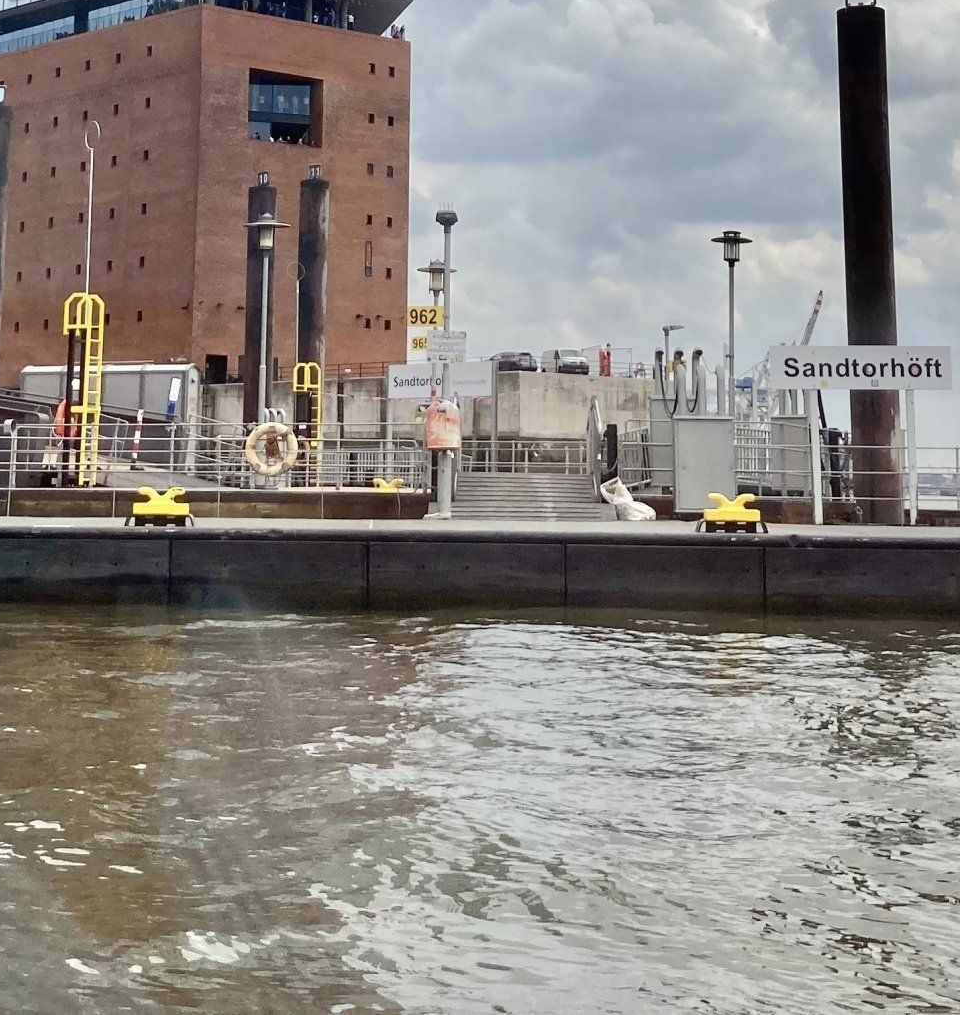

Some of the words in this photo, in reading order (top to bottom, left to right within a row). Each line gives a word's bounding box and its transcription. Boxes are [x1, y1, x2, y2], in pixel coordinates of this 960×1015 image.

[259, 173, 268, 184] 10
[409, 309, 437, 324] 962
[783, 357, 943, 378] Sandtorhöft
